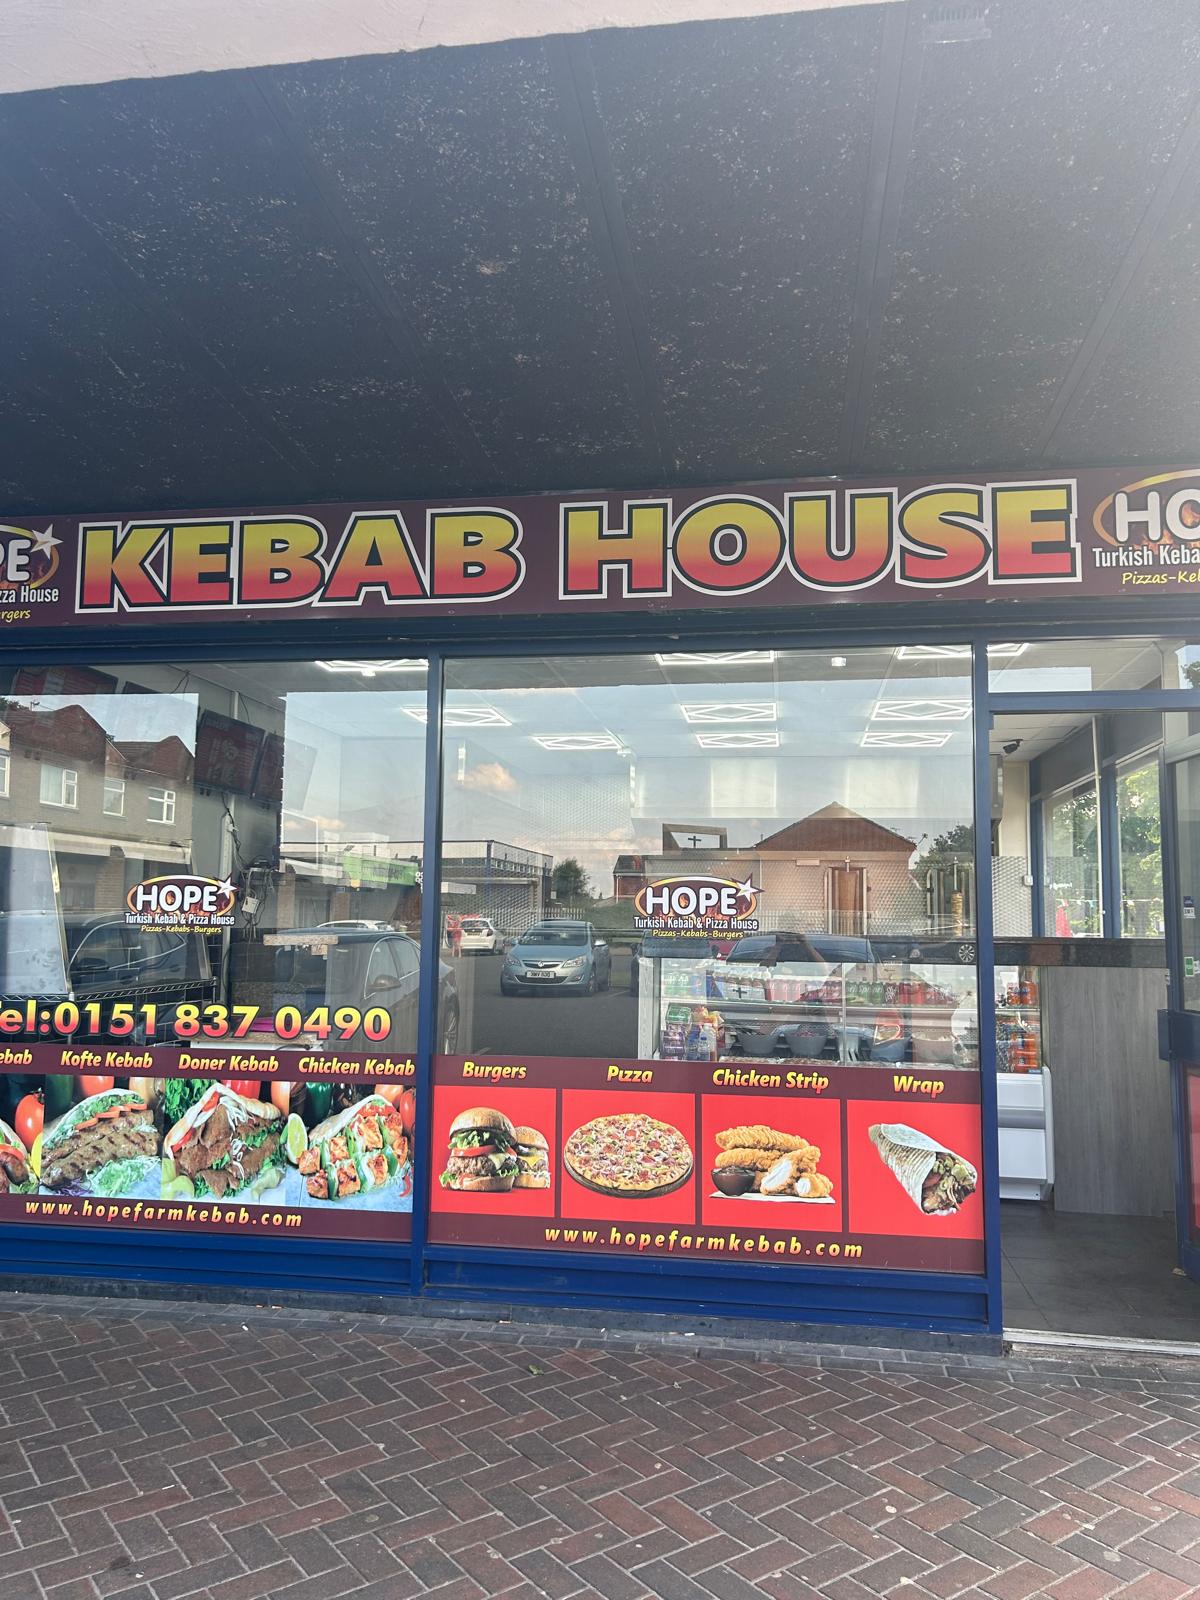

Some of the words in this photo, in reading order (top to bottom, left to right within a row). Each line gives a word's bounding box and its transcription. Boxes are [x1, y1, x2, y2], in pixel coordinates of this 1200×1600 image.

[75, 506, 526, 614] KEBAB
[558, 478, 1082, 600] HOUSE
[1092, 545, 1153, 568] Turkish
[0, 539, 32, 582] E
[20, 585, 59, 603] House
[0, 610, 31, 623] rgers
[136, 884, 218, 912] HOPE
[646, 886, 738, 916] HOPE
[125, 912, 153, 924] Turkish
[154, 912, 178, 924] Kebab
[180, 912, 187, 924] &
[188, 913, 209, 925] Pizza
[210, 913, 235, 925] House
[634, 916, 665, 929] Turkish
[667, 917, 694, 929] Kebab
[696, 917, 703, 929] &
[705, 917, 728, 929] Pizza
[731, 918, 758, 930] House
[0, 999, 157, 1036] el:0151
[174, 1003, 260, 1038] 837
[274, 1006, 392, 1042] 0490
[61, 1051, 101, 1069] Kofte
[105, 1052, 153, 1068] Kebab
[178, 1054, 226, 1071] Doner
[229, 1055, 279, 1072] Kebab
[298, 1057, 360, 1074] Chicken
[364, 1059, 415, 1076] Kebab
[462, 1061, 527, 1083] Burgers
[606, 1065, 653, 1083] Pizza
[712, 1068, 781, 1088] Chicken
[785, 1071, 829, 1094] Strip
[893, 1075, 944, 1099] Wrap
[25, 1200, 303, 1228] www.hopefarmkebab.com
[544, 1226, 864, 1259] www.hopefarmkebab.com
